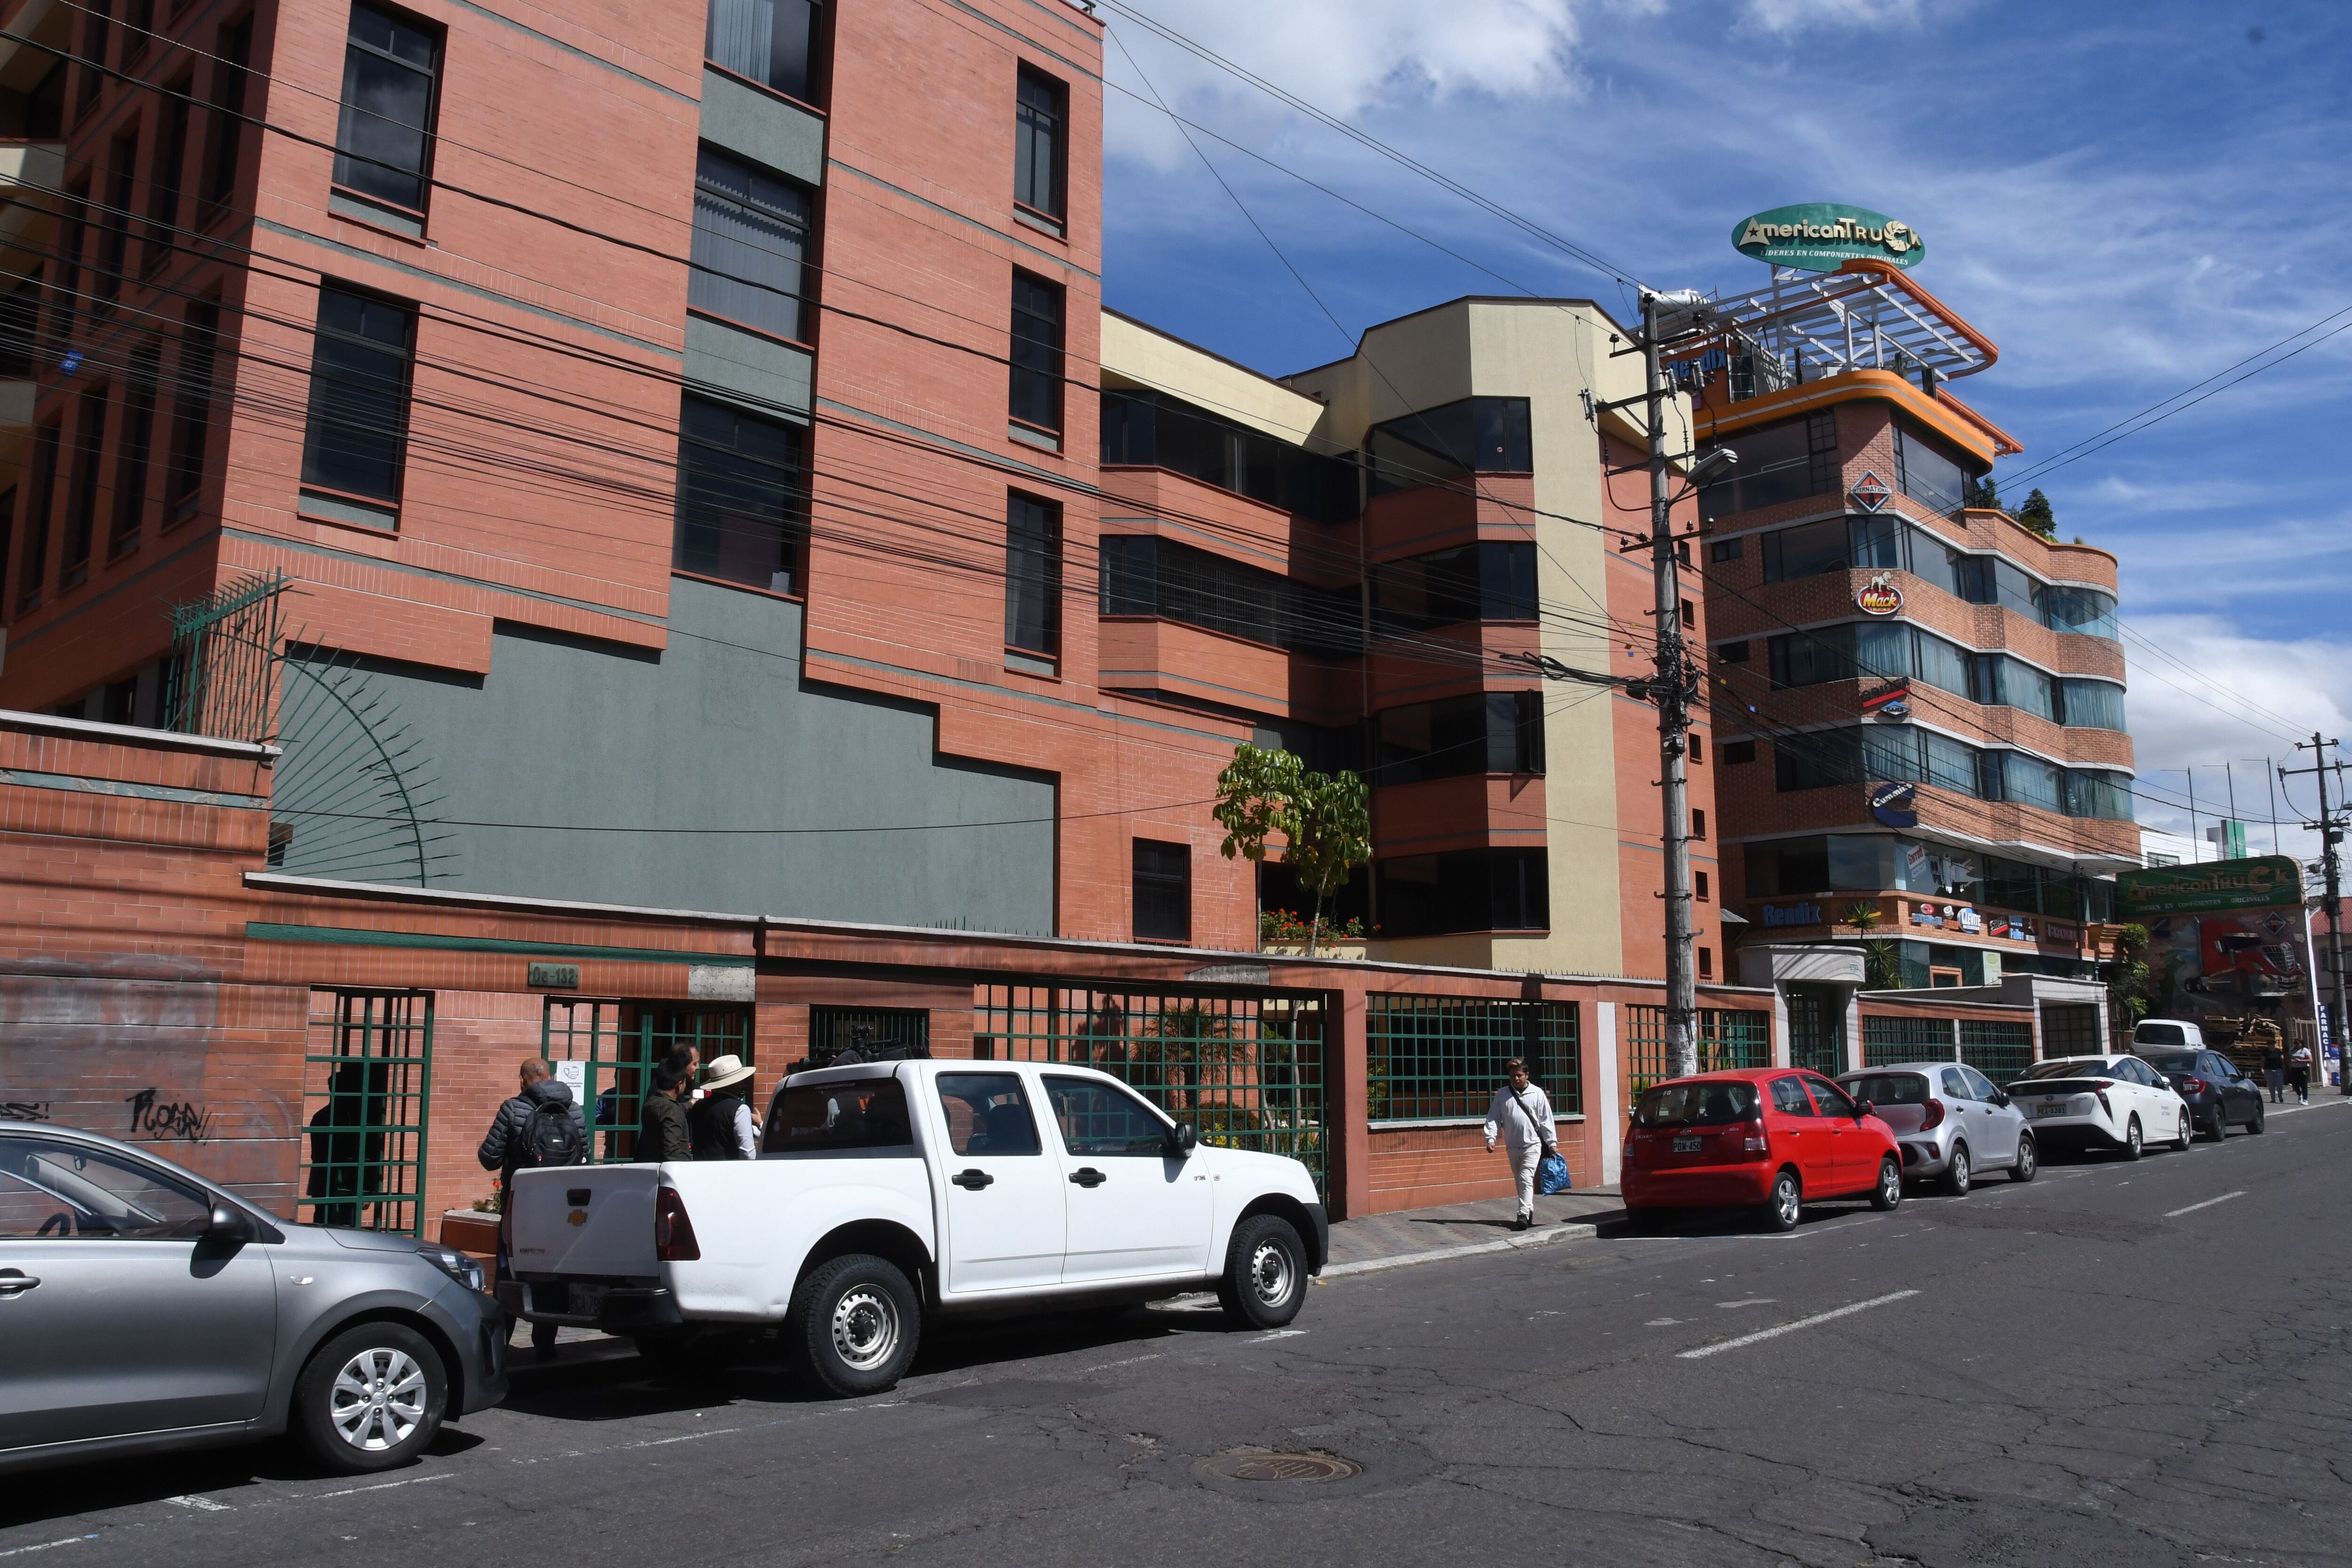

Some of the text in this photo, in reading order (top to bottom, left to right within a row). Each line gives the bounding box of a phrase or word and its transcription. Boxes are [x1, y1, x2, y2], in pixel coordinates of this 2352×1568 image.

[1809, 250, 1865, 259] COMPONENTES
[1863, 593, 1897, 606] Mack
[1873, 783, 1912, 807] Cummins
[1763, 902, 1821, 926] Bendix
[1962, 911, 1981, 926] CLEVITE
[2320, 1006, 2330, 1058] FARMACIA
